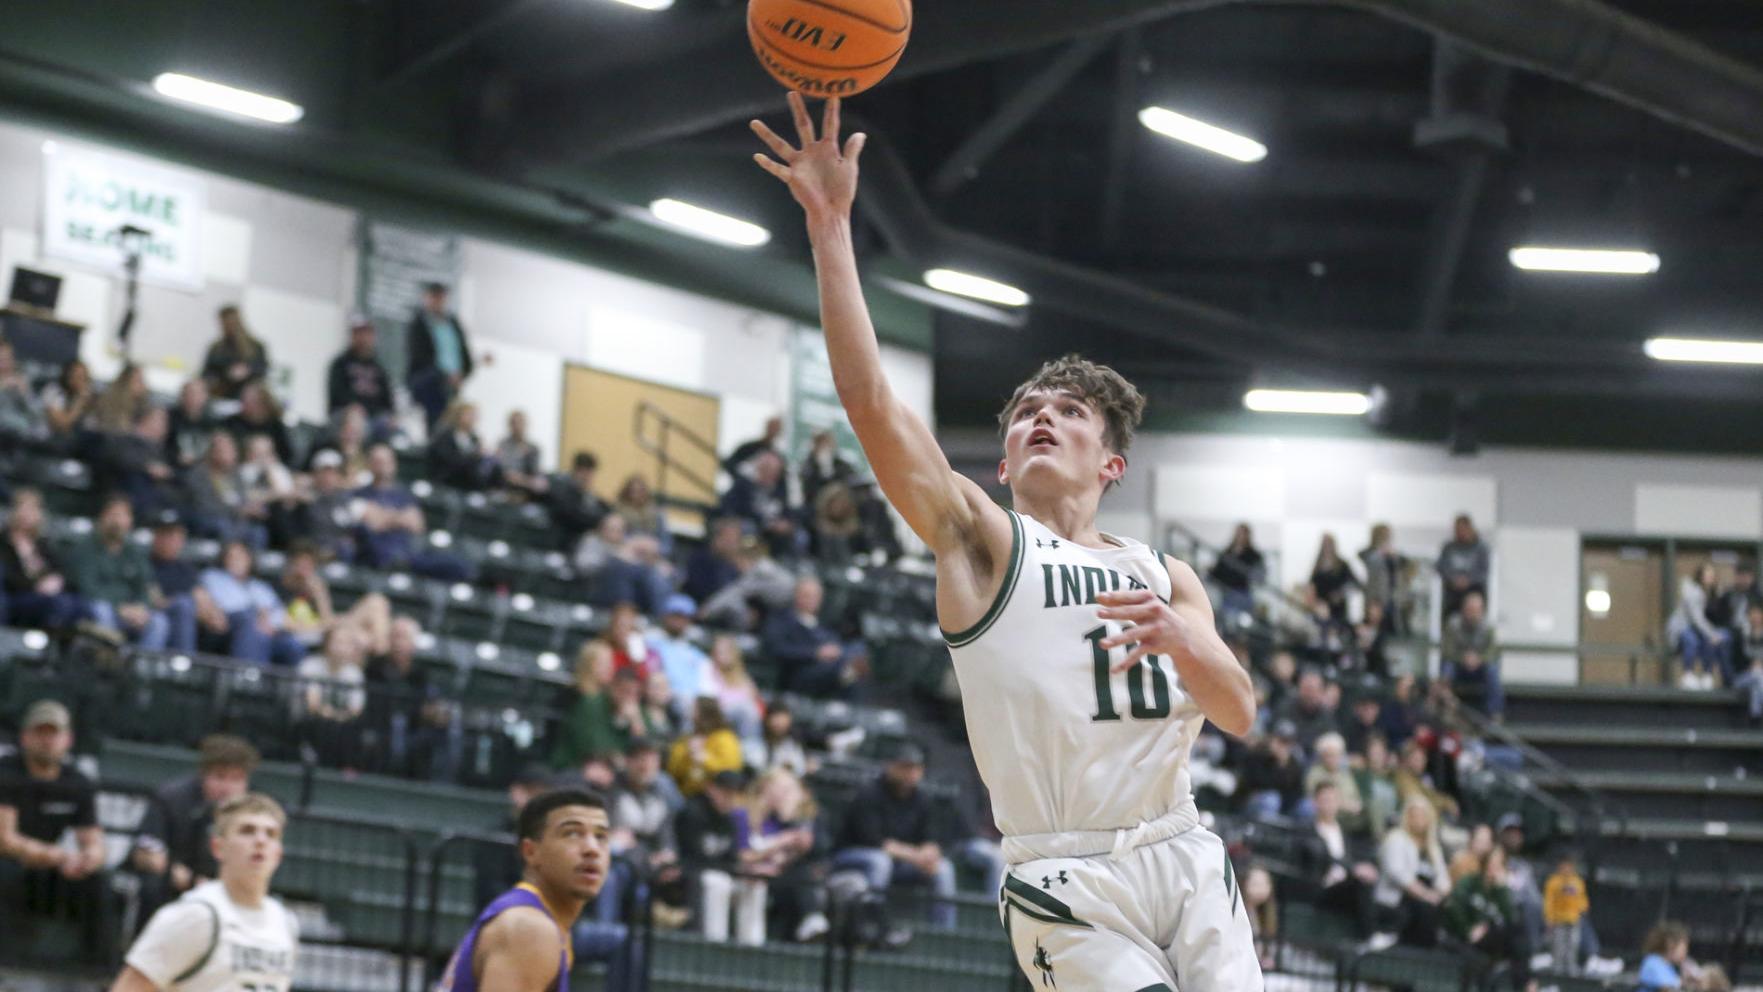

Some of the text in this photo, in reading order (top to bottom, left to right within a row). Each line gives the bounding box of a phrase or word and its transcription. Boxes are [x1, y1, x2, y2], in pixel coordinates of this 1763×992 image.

[781, 17, 847, 51] EVO
[1041, 563, 1148, 609] INDI
[1083, 623, 1172, 722] 10
